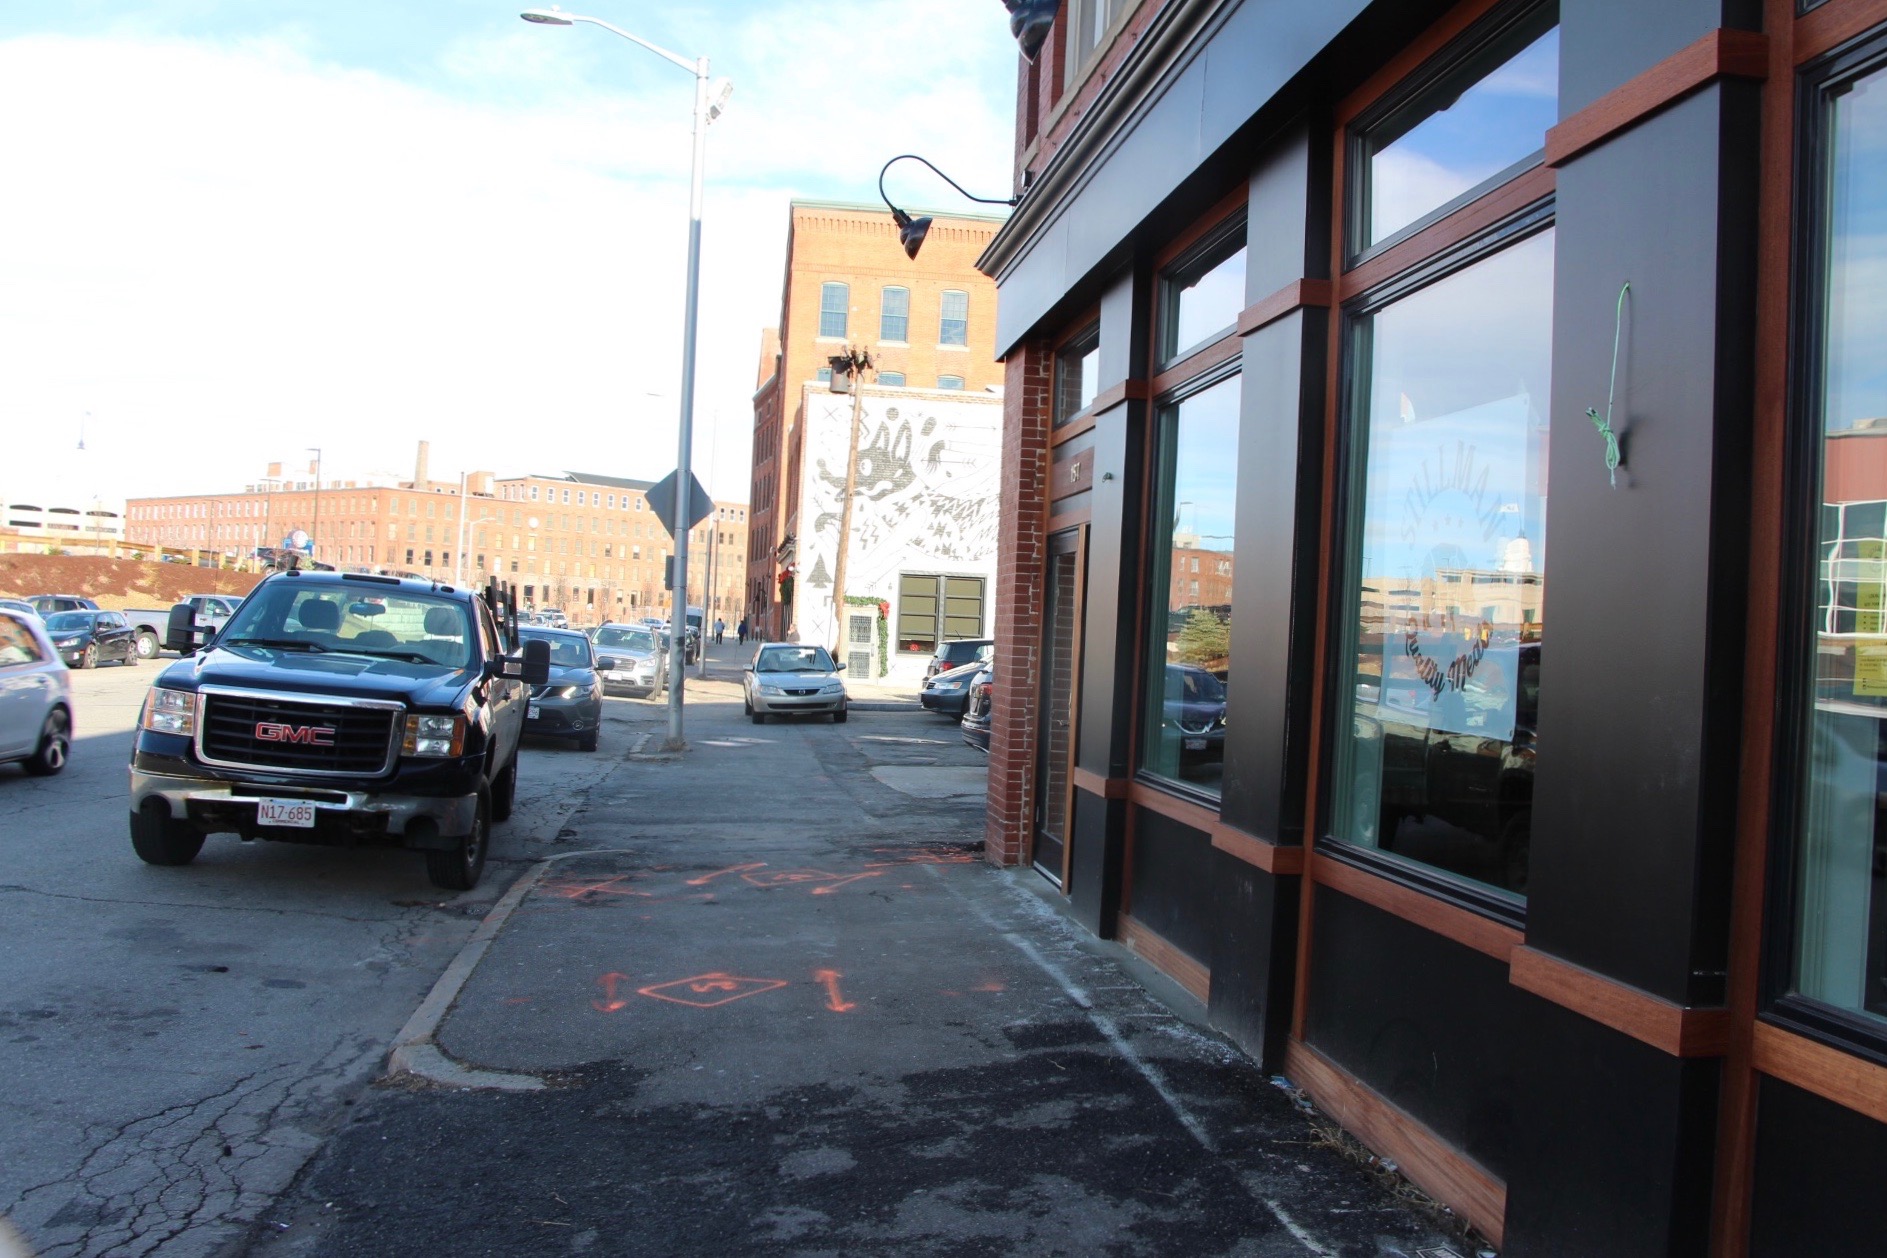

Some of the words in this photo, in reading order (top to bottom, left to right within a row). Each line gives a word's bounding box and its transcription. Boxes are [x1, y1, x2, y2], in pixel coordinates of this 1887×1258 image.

[1070, 462, 1081, 483] 157
[1401, 440, 1507, 549] STILLMAN
[1405, 617, 1445, 702] Quality
[255, 722, 335, 746] GMC
